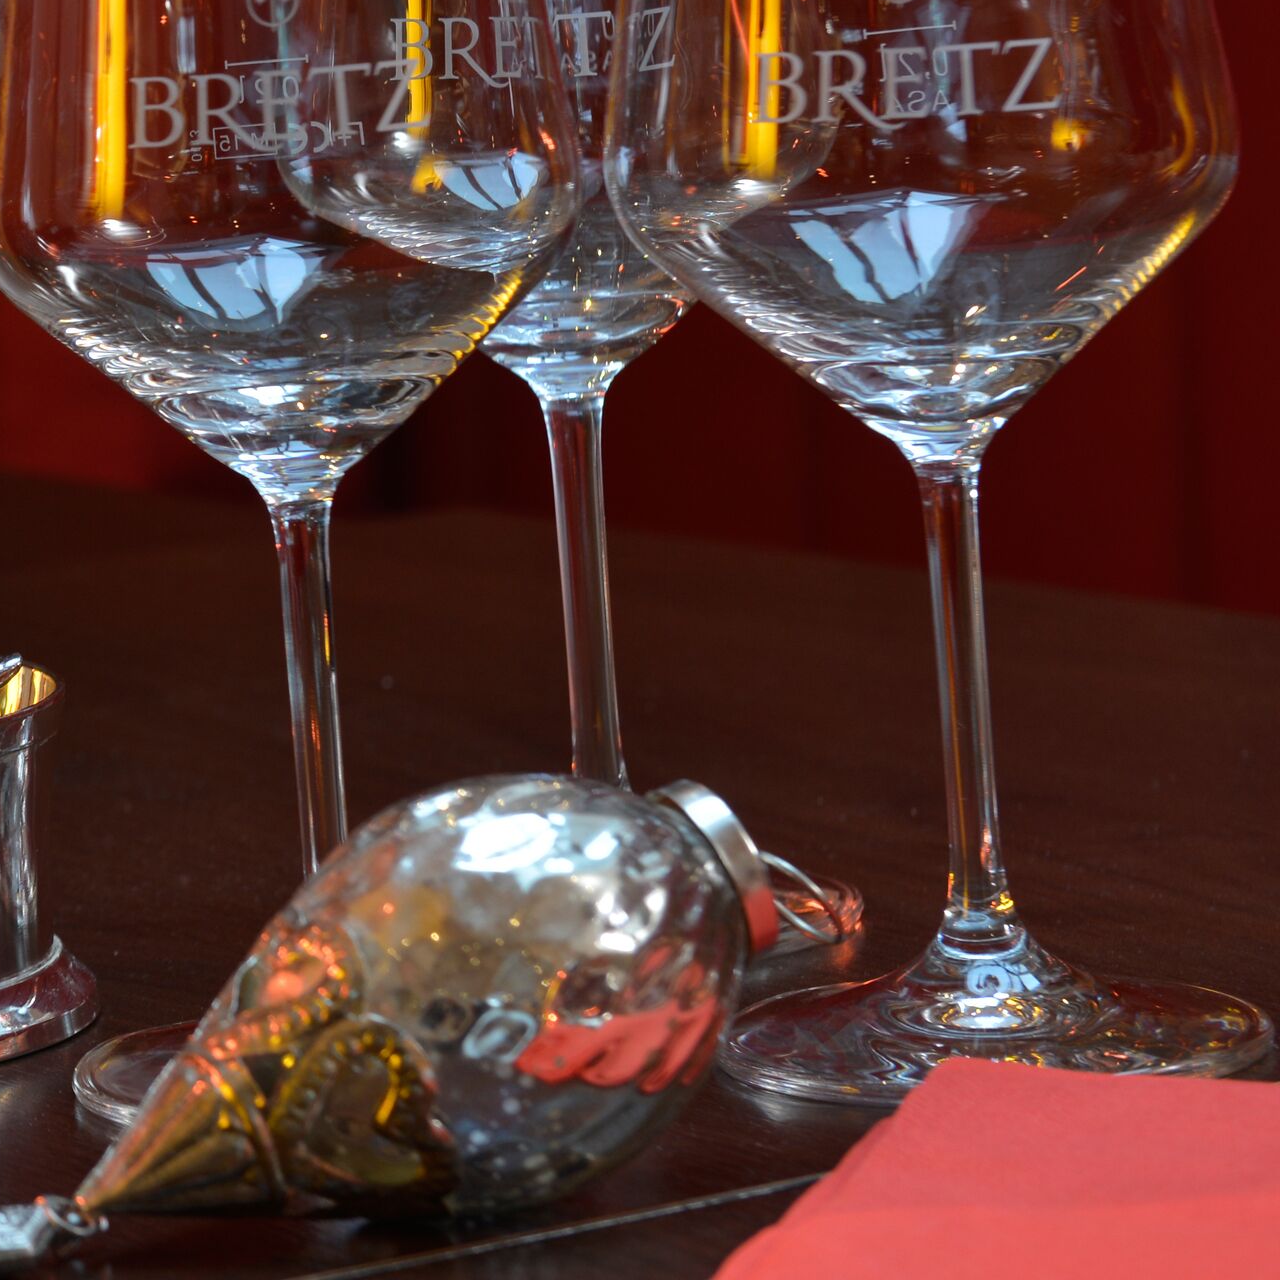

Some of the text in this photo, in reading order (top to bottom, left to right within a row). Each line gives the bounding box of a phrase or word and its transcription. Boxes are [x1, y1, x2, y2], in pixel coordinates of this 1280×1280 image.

[390, 6, 676, 88] BRETZ
[751, 37, 1062, 131] BRETZ
[129, 58, 431, 154] BRETZ
